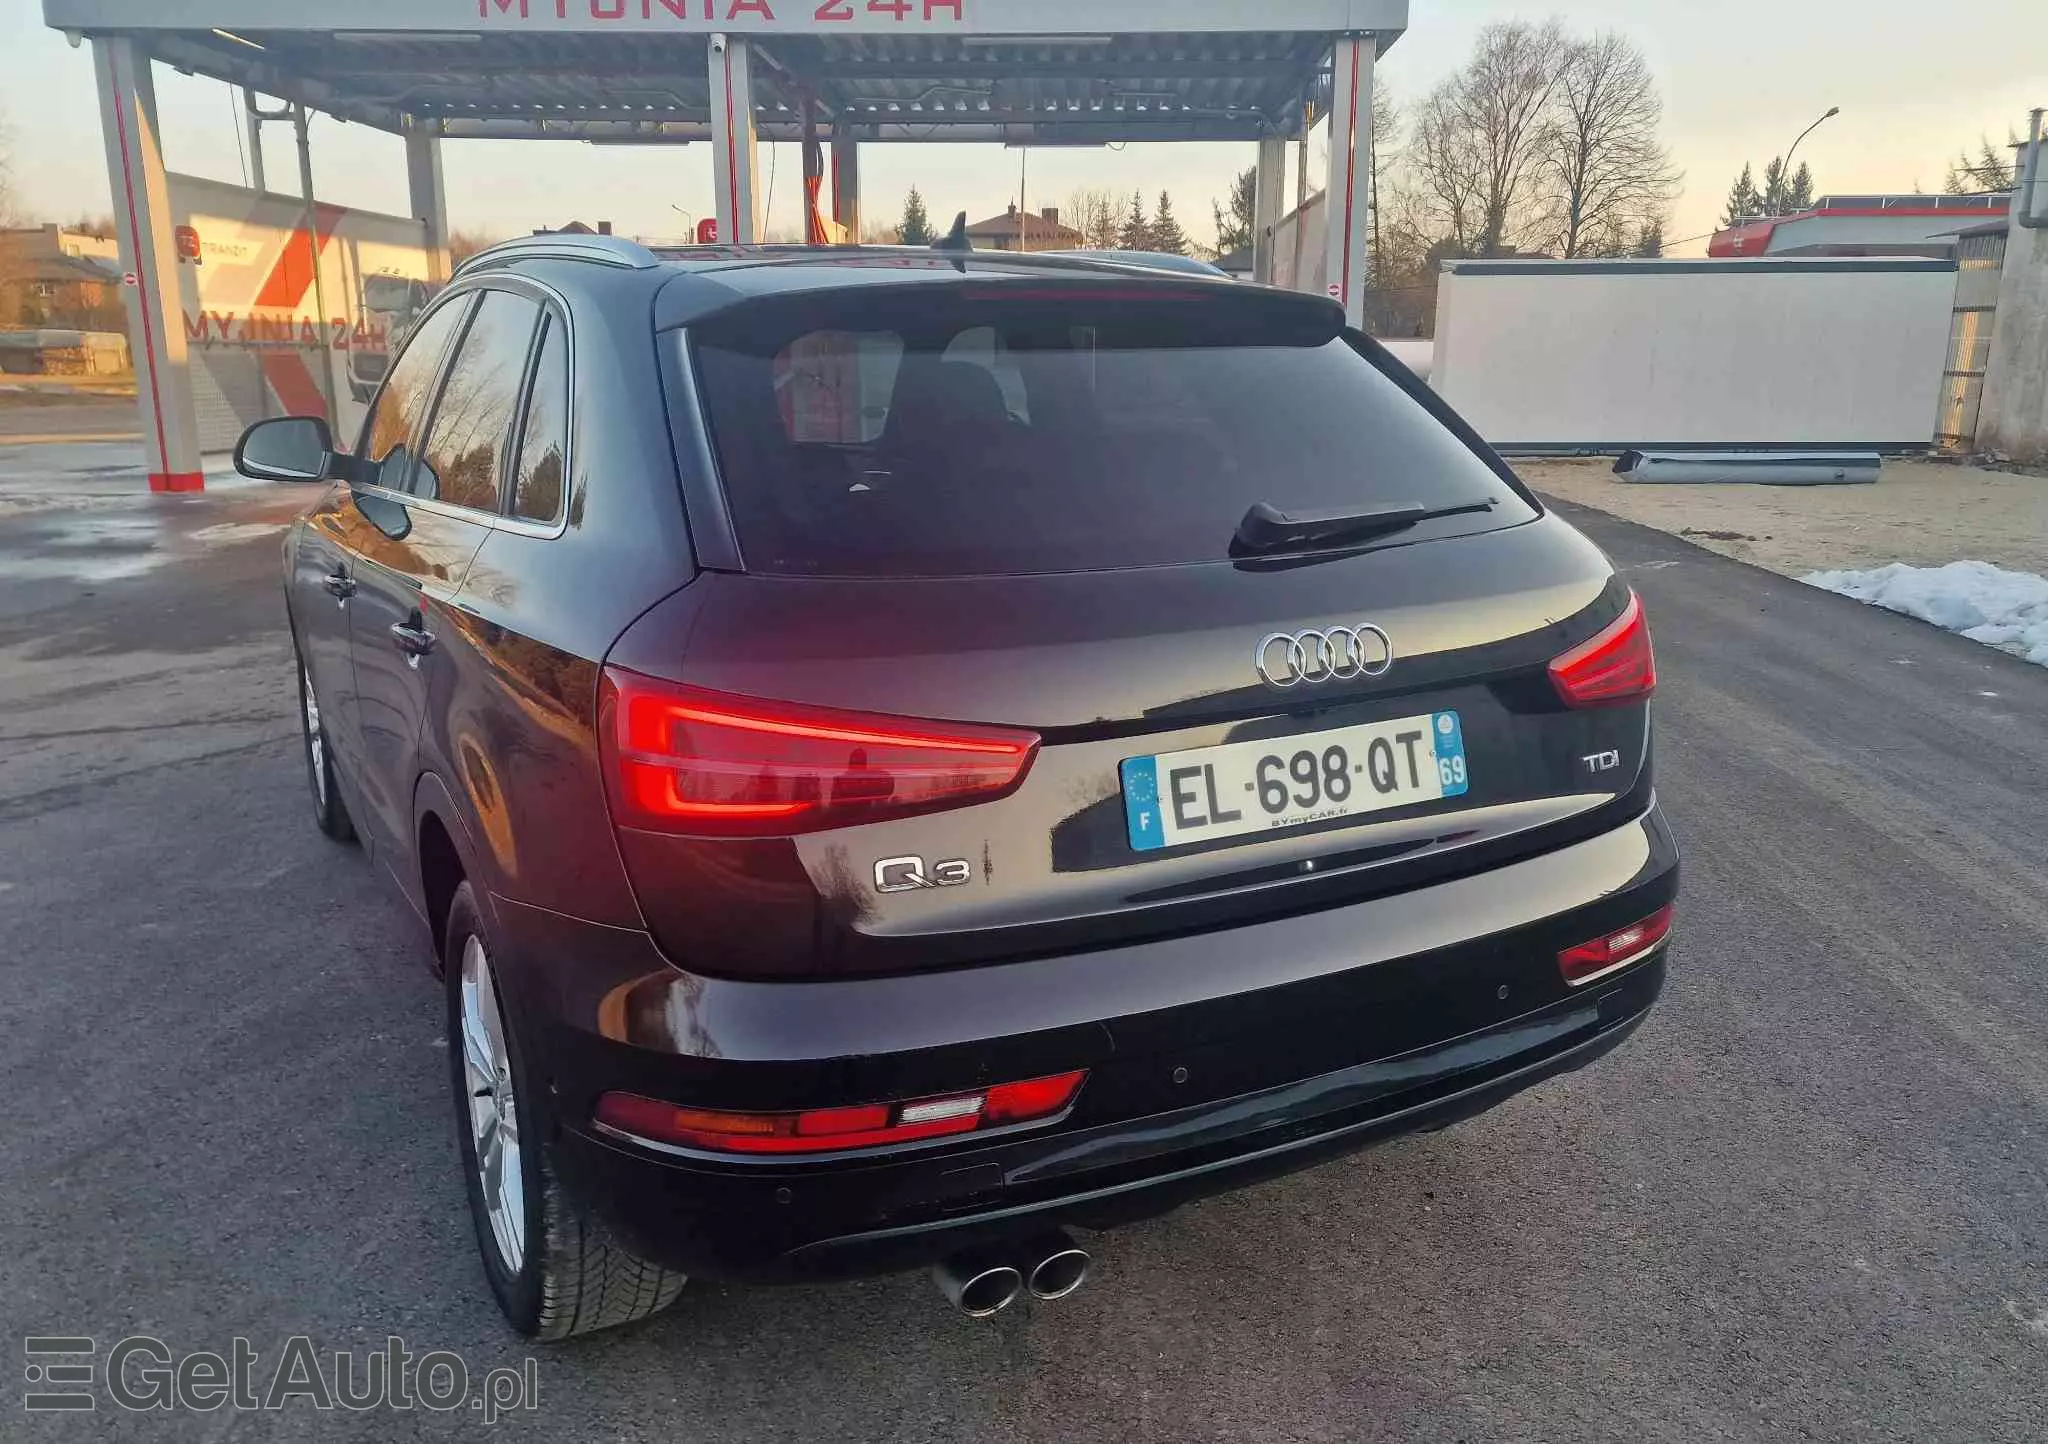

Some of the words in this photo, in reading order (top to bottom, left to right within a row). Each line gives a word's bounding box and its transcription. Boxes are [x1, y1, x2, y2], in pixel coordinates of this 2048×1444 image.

[332, 317, 386, 350] 24H
[1440, 754, 1465, 785] 69
[1582, 749, 1620, 773] TDI
[1169, 730, 1423, 831] EL-698-QT
[1139, 811, 1151, 831] F
[874, 855, 970, 893] Q3
